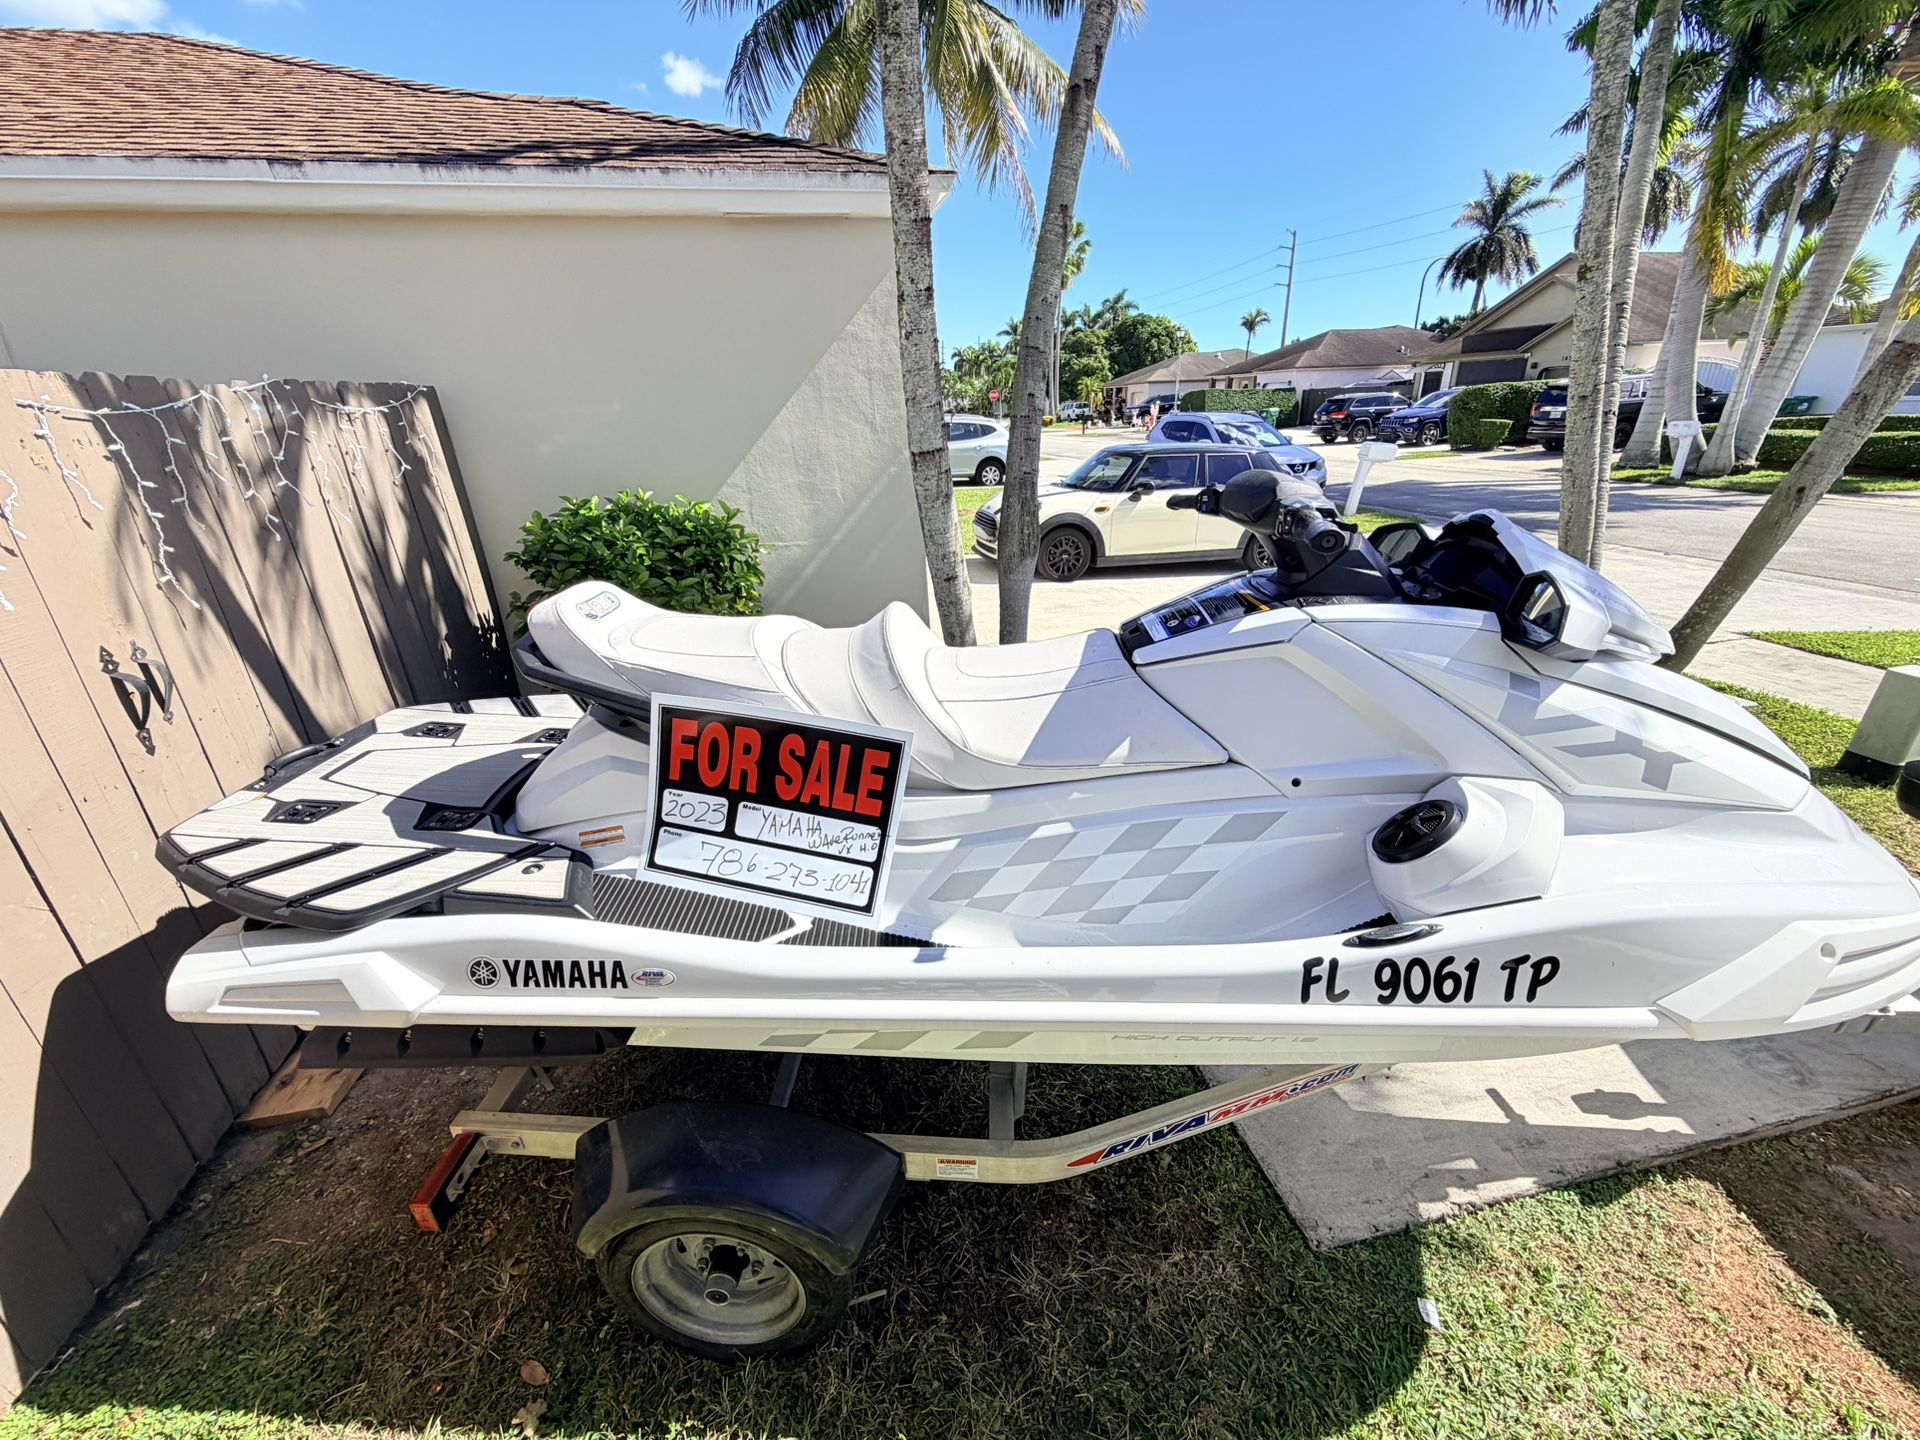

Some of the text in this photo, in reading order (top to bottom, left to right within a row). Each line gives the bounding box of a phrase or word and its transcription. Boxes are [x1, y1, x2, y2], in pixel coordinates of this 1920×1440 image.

[668, 717, 890, 817] FOR SALE
[664, 800, 726, 825] 2023
[742, 803, 762, 812] Model
[663, 829, 683, 837] Phone
[757, 809, 823, 840] YAMAHA
[701, 841, 870, 894] 786-273-1041
[502, 959, 629, 989] YAMAHA
[1300, 954, 1560, 1005] FL 9061 TP
